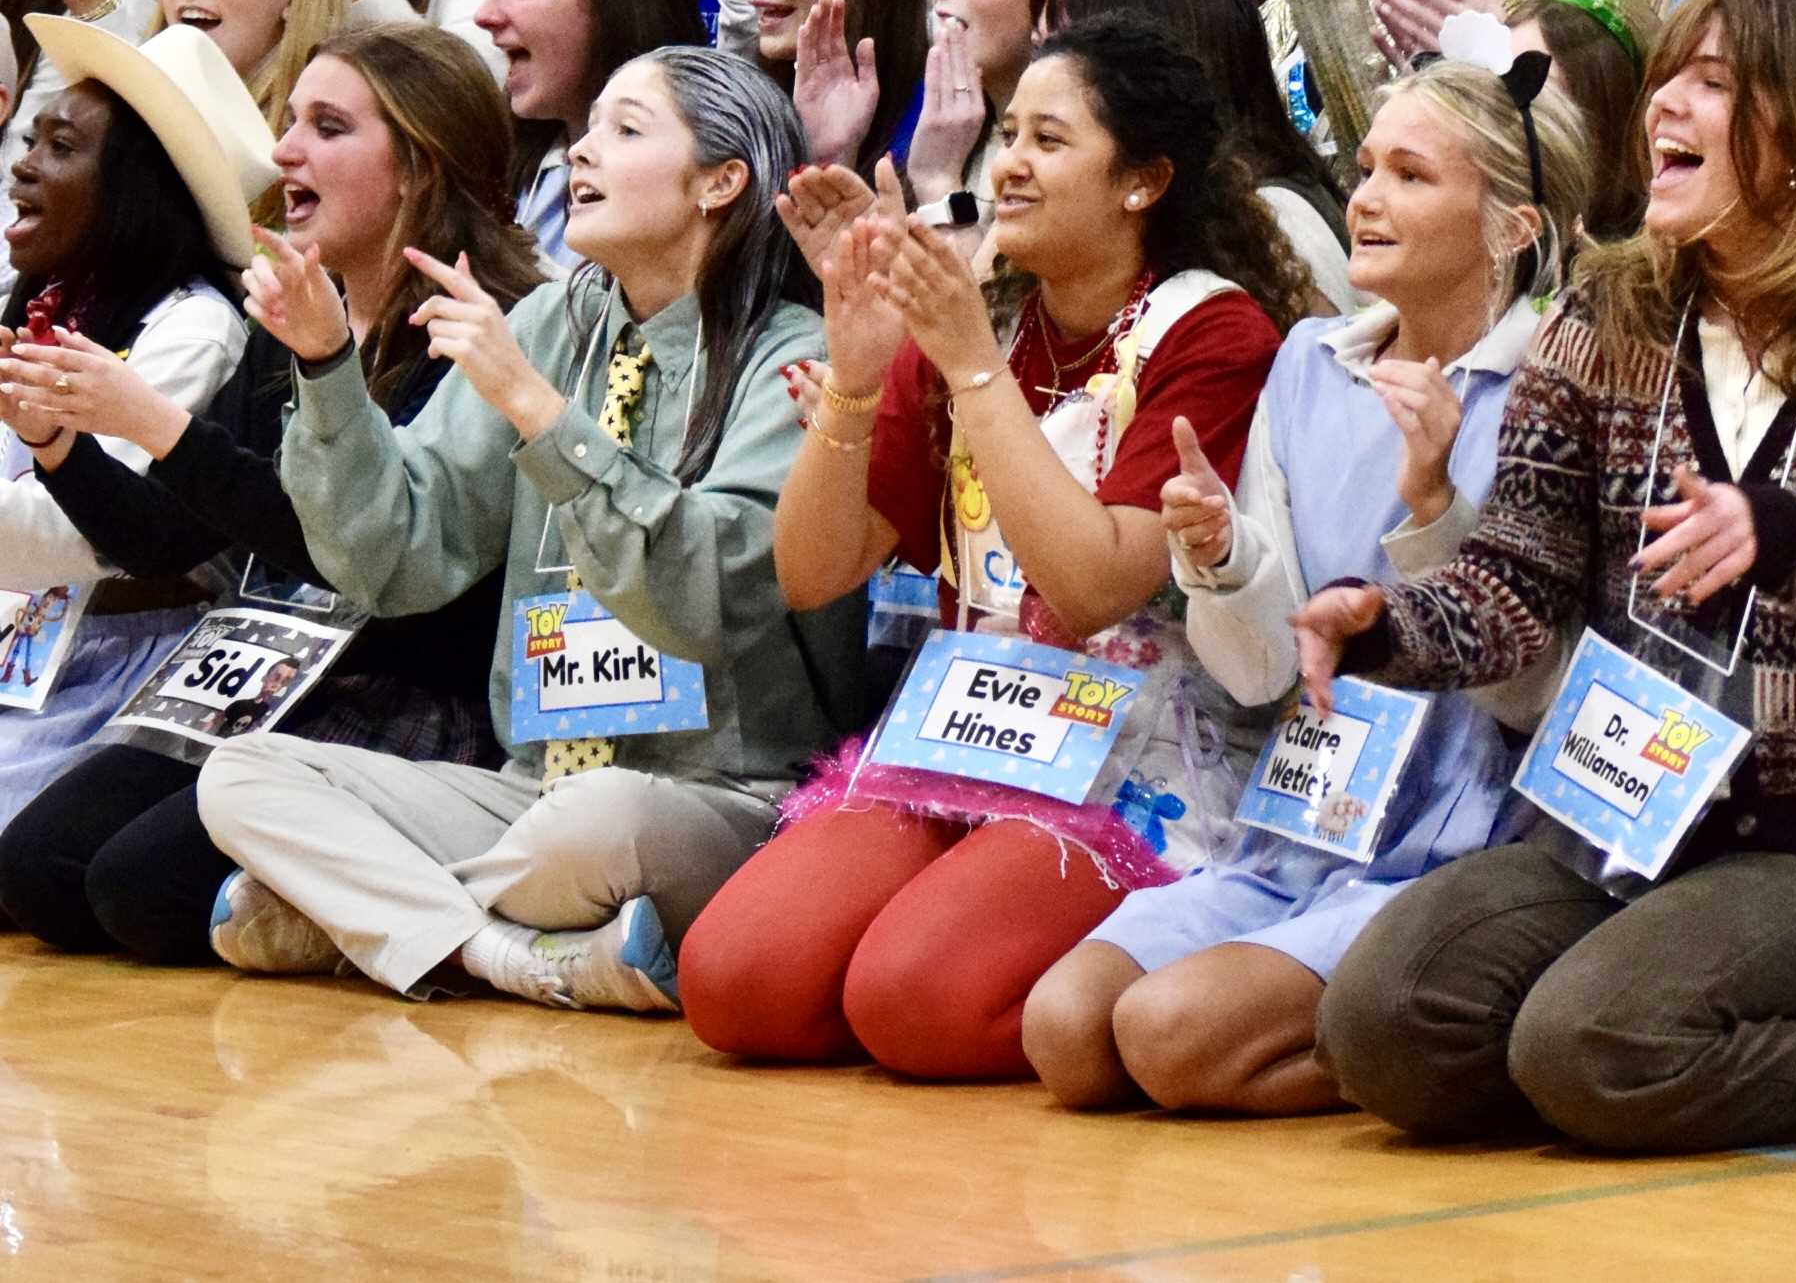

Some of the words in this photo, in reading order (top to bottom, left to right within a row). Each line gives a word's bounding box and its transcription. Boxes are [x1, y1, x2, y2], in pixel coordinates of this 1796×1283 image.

[527, 603, 568, 637] TOY
[529, 636, 563, 653] STORY
[184, 649, 266, 698] Sid
[543, 654, 584, 688] Mr.
[593, 645, 657, 683] Kirk
[966, 668, 1041, 709] Evie
[1064, 670, 1134, 710] TOY
[941, 710, 1036, 755] Hines
[1056, 702, 1108, 724] STORY
[1604, 714, 1630, 747] Dr.
[1663, 708, 1714, 754] TOY
[1285, 715, 1341, 755] Claire
[1563, 730, 1650, 803] Williamson
[1647, 741, 1687, 770] STORY
